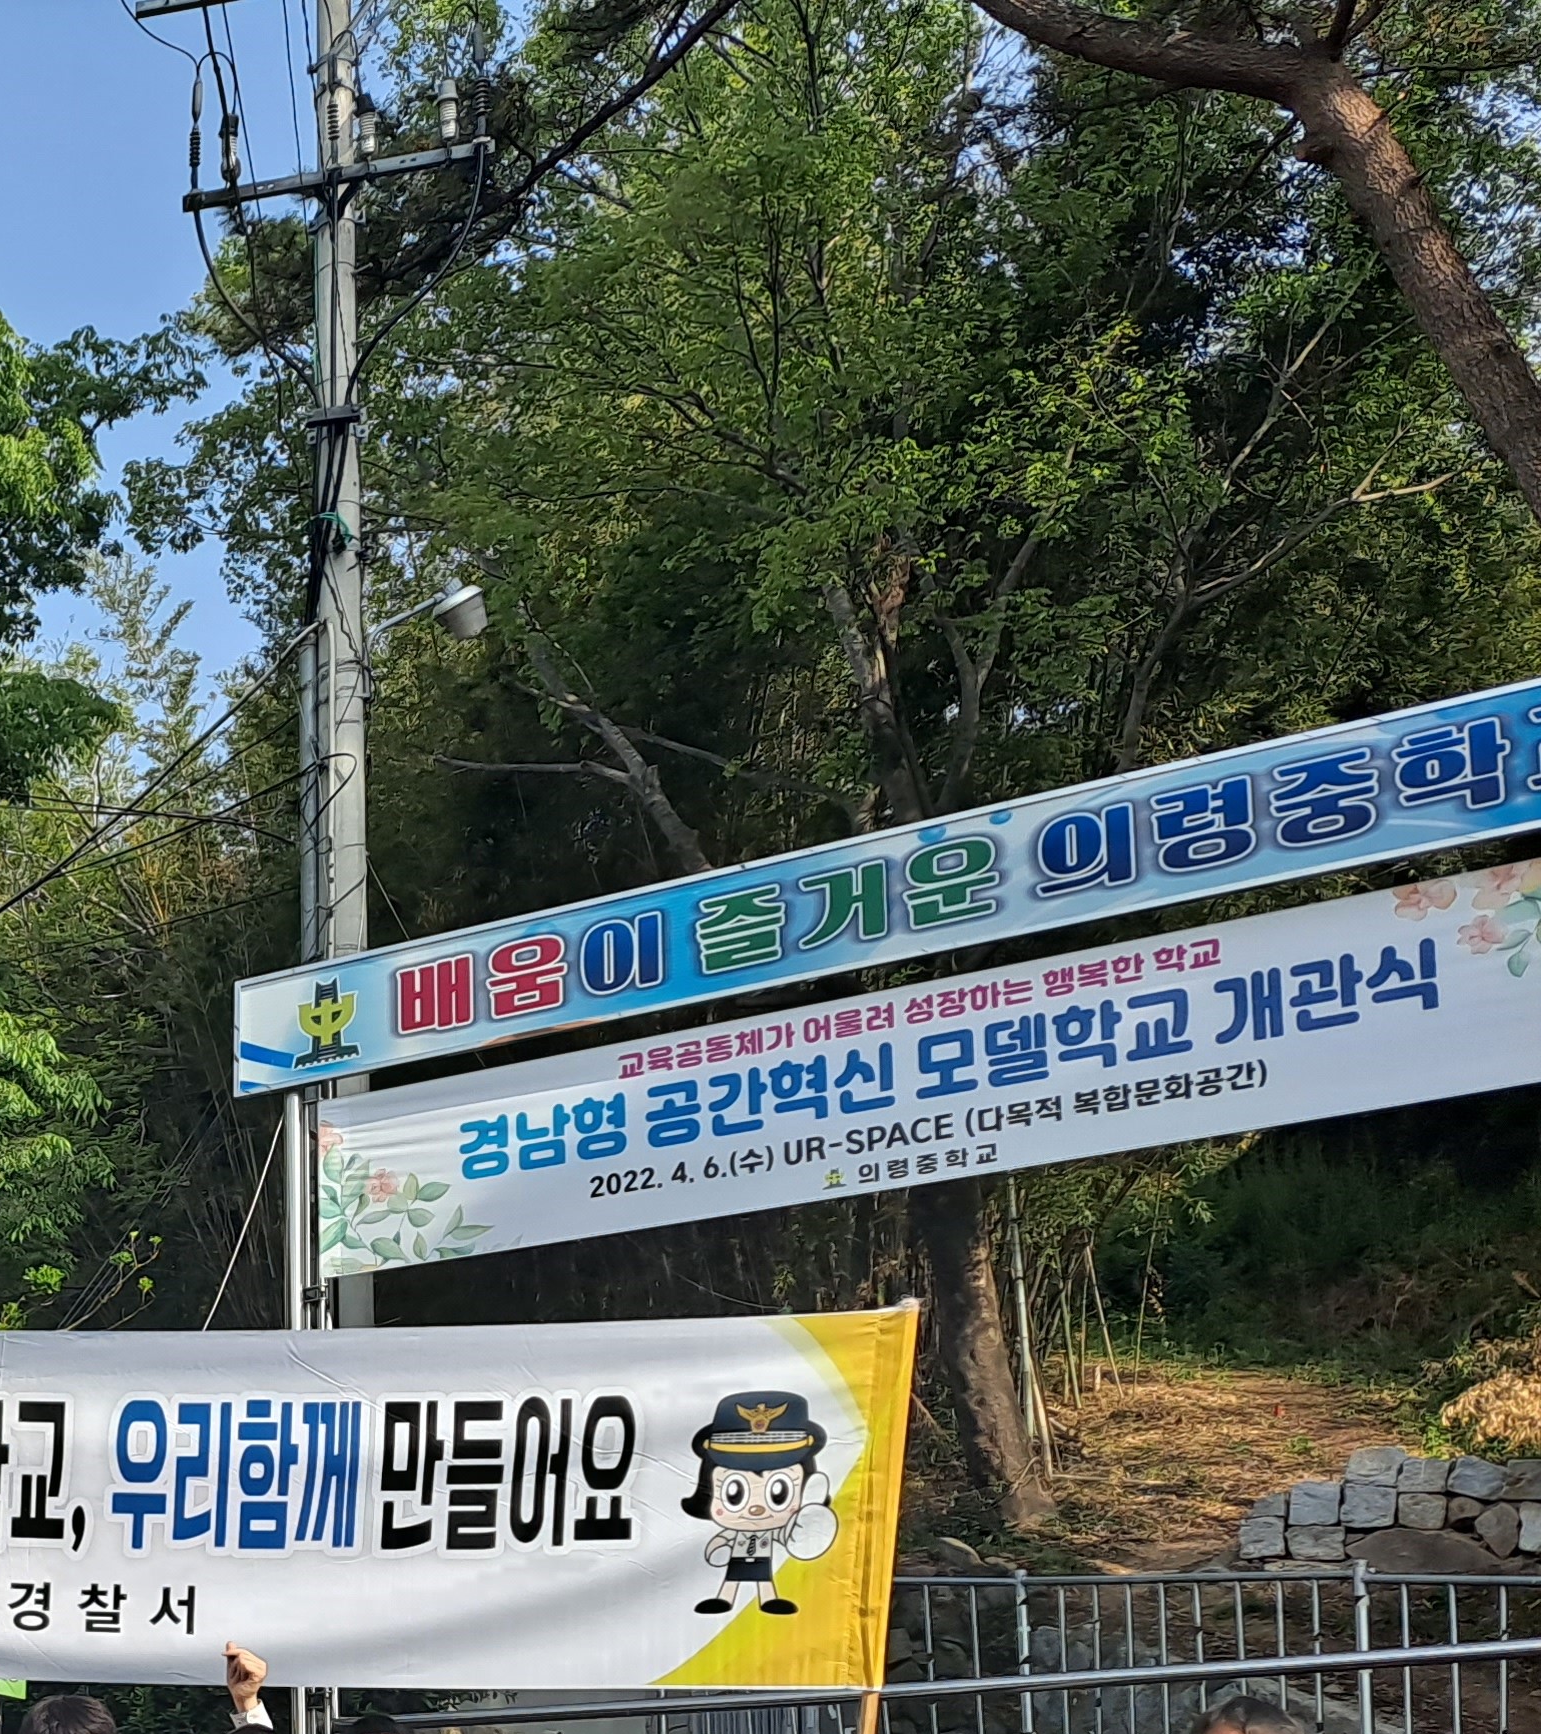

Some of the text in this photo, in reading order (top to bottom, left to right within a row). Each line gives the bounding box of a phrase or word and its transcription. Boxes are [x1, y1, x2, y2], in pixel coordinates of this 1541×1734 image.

[398, 700, 1541, 1035] 배움이 즐거운 의령중학
[458, 937, 1440, 1181] 경남형 공간혁신 모델학교 개관식
[617, 938, 1222, 1080] 교육공동체가 어울려 성장하는 행복한 학교
[589, 1058, 1269, 1199] 2022. 4. 6.(수) UR-SPACE (다목적 복합문화공간)
[857, 1145, 998, 1184] 의령중학교
[114, 1399, 362, 1551] 우리함께
[380, 1394, 638, 1551] 만들어요
